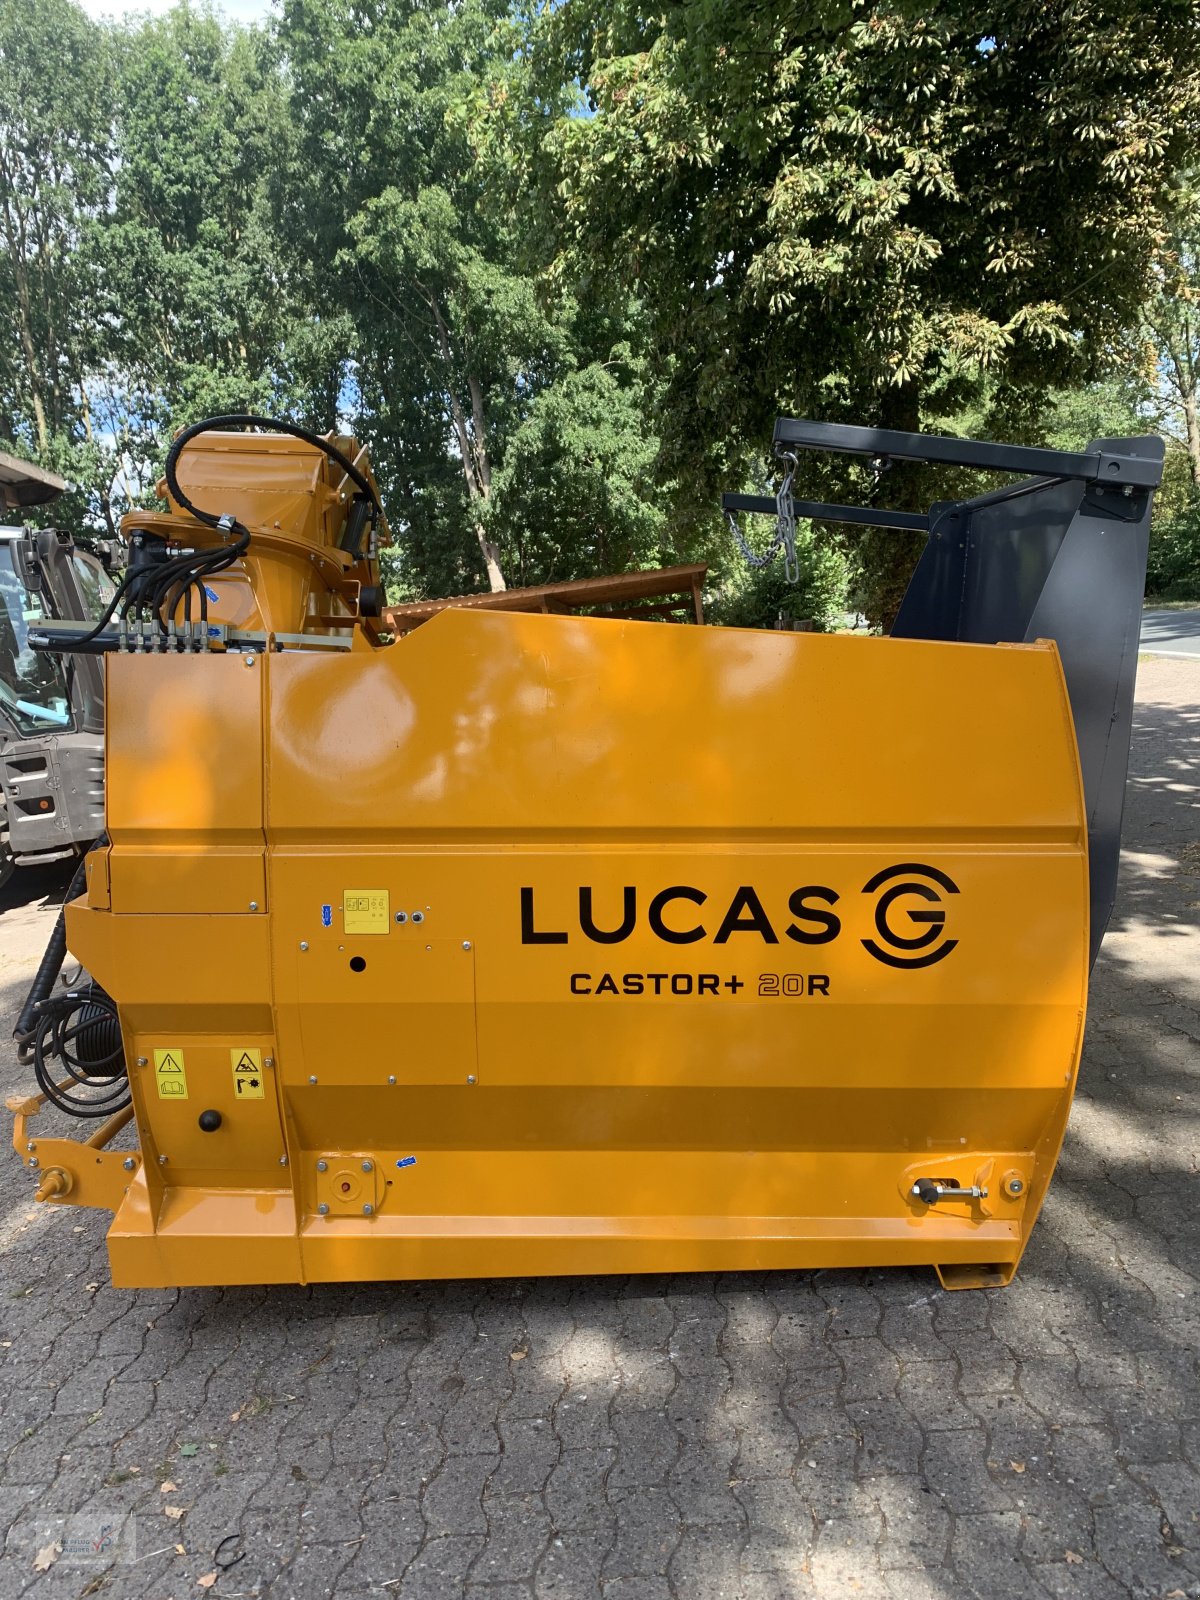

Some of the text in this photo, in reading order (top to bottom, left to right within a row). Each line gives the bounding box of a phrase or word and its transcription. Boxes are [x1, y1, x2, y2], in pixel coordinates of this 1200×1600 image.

[520, 885, 842, 945] LUCAS
[570, 973, 831, 997] CASTOR+ 20R
